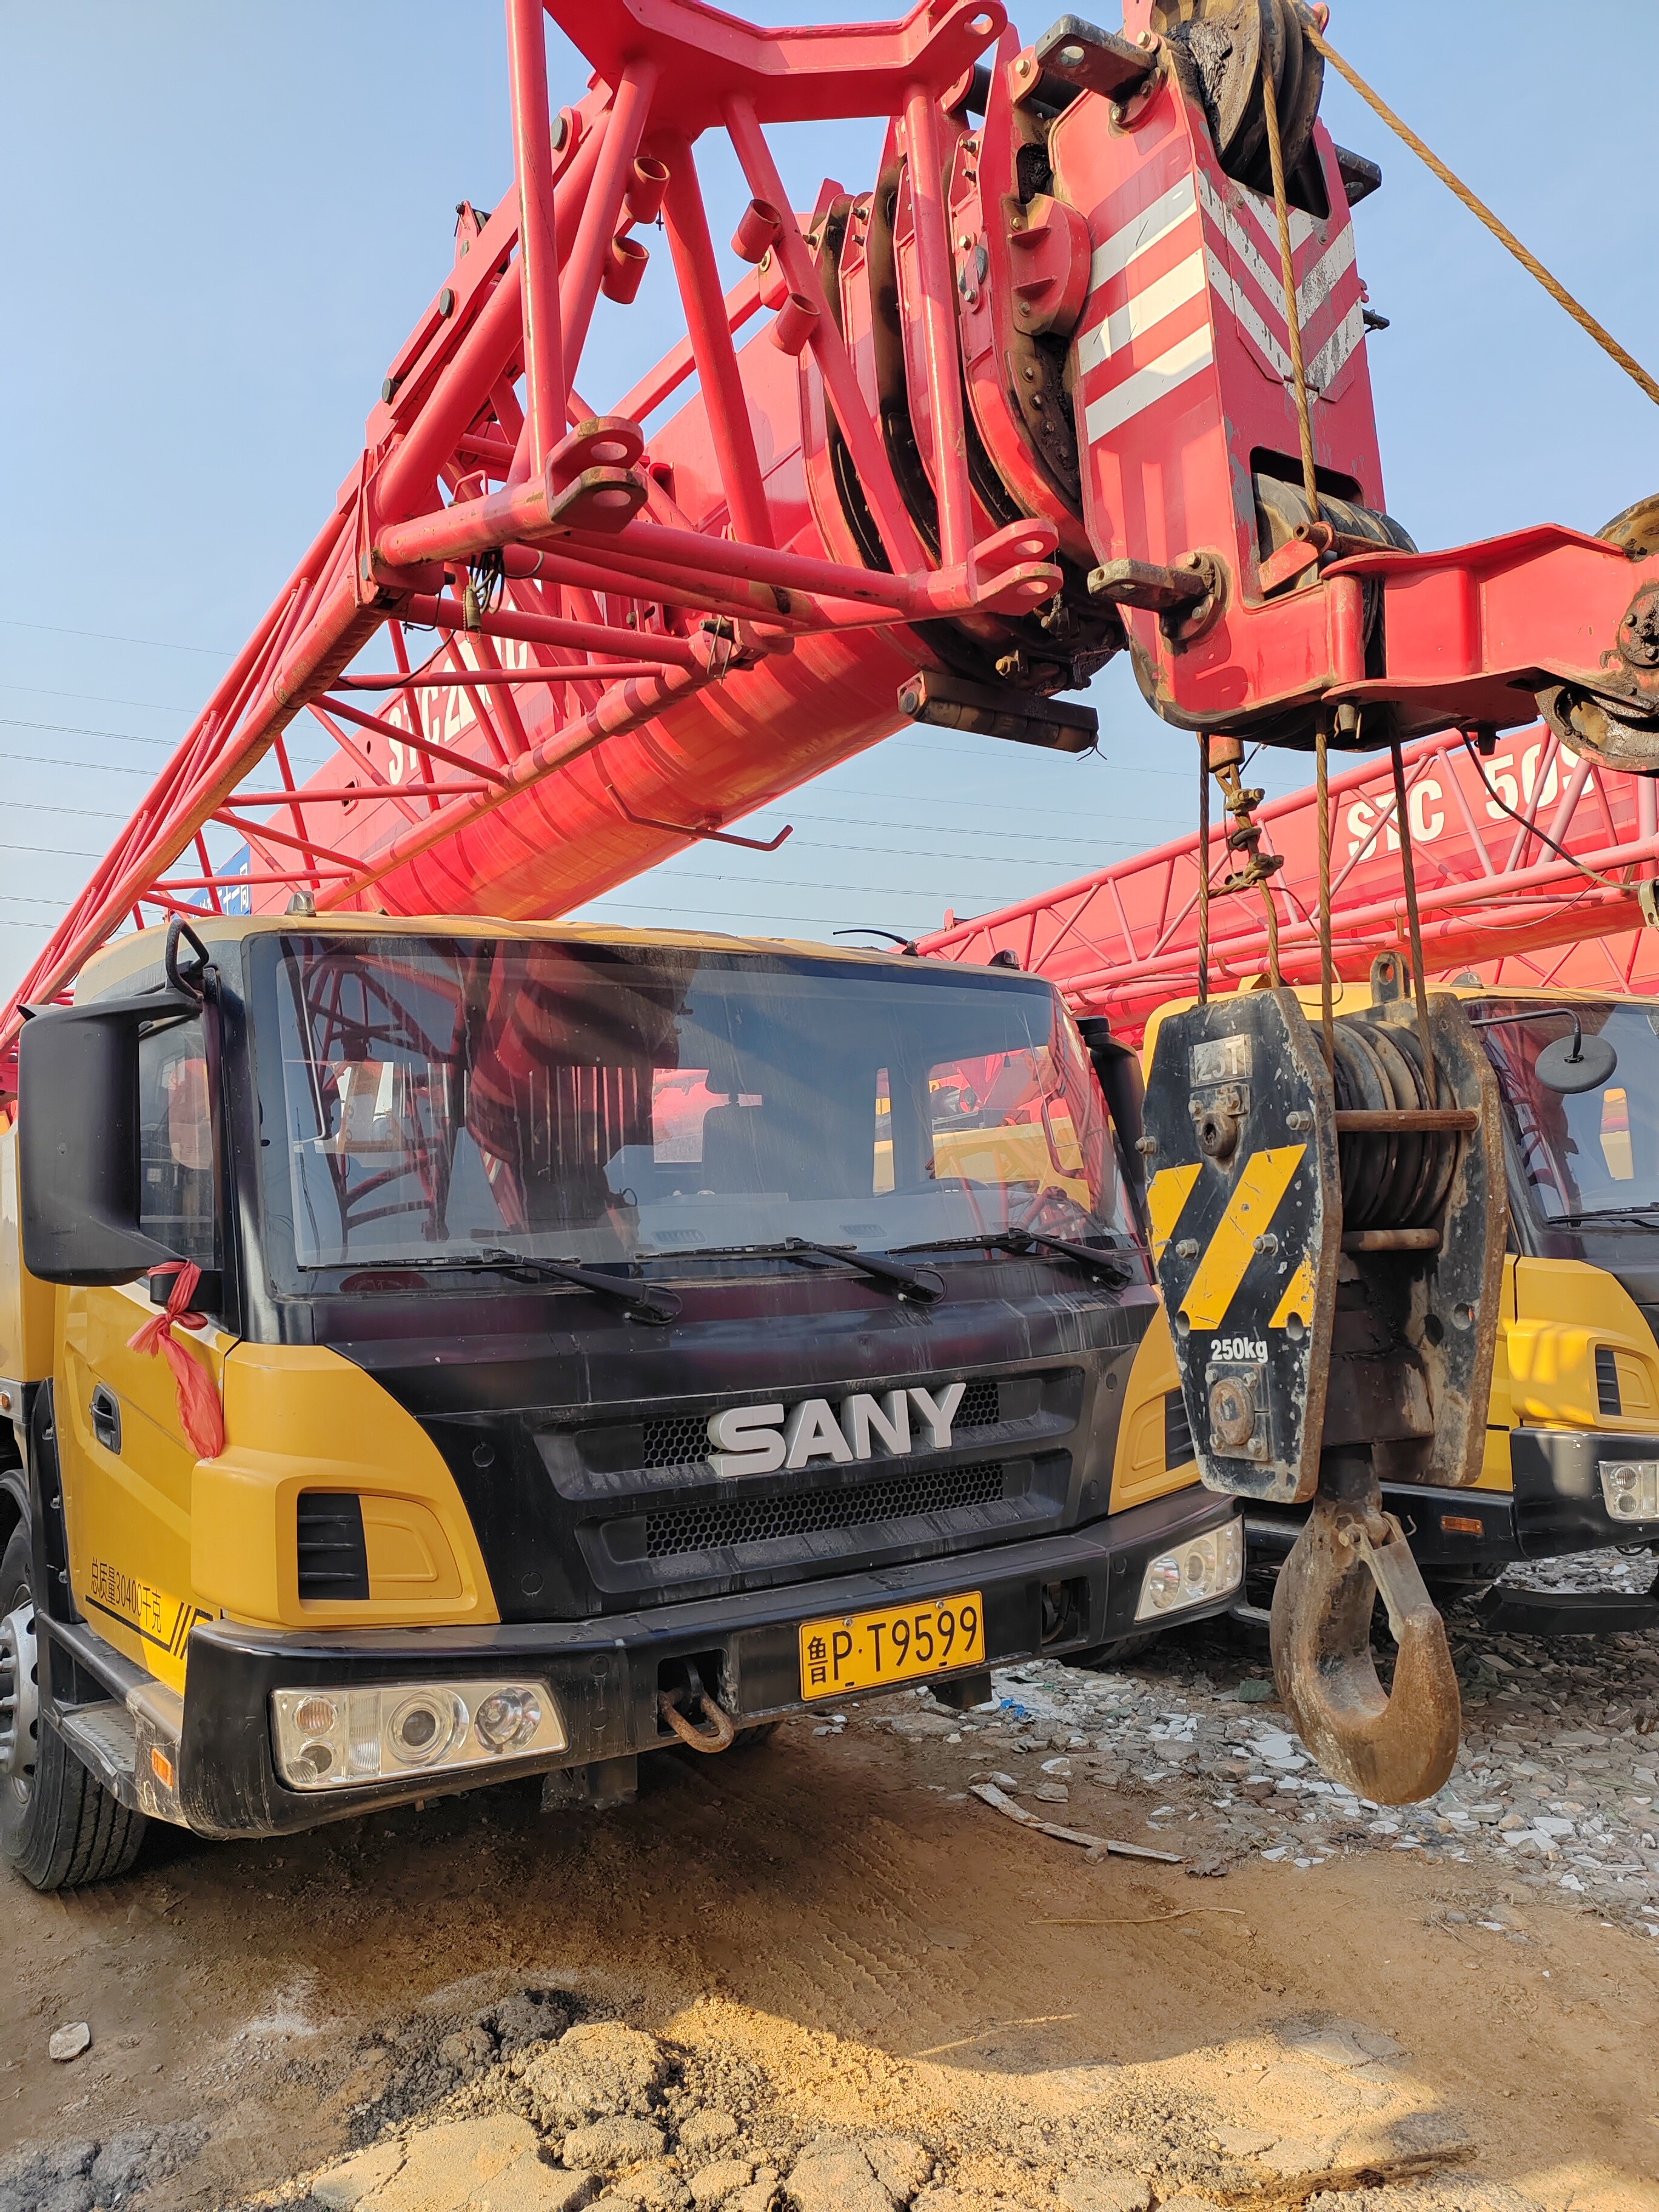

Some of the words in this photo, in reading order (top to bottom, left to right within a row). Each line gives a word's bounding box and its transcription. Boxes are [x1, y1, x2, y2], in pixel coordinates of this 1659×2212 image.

[1196, 1040, 1242, 1081] 25T
[1211, 1337, 1268, 1362] 250kg
[708, 1383, 966, 1478] SANY
[91, 1557, 162, 1634] 总质量30400千克
